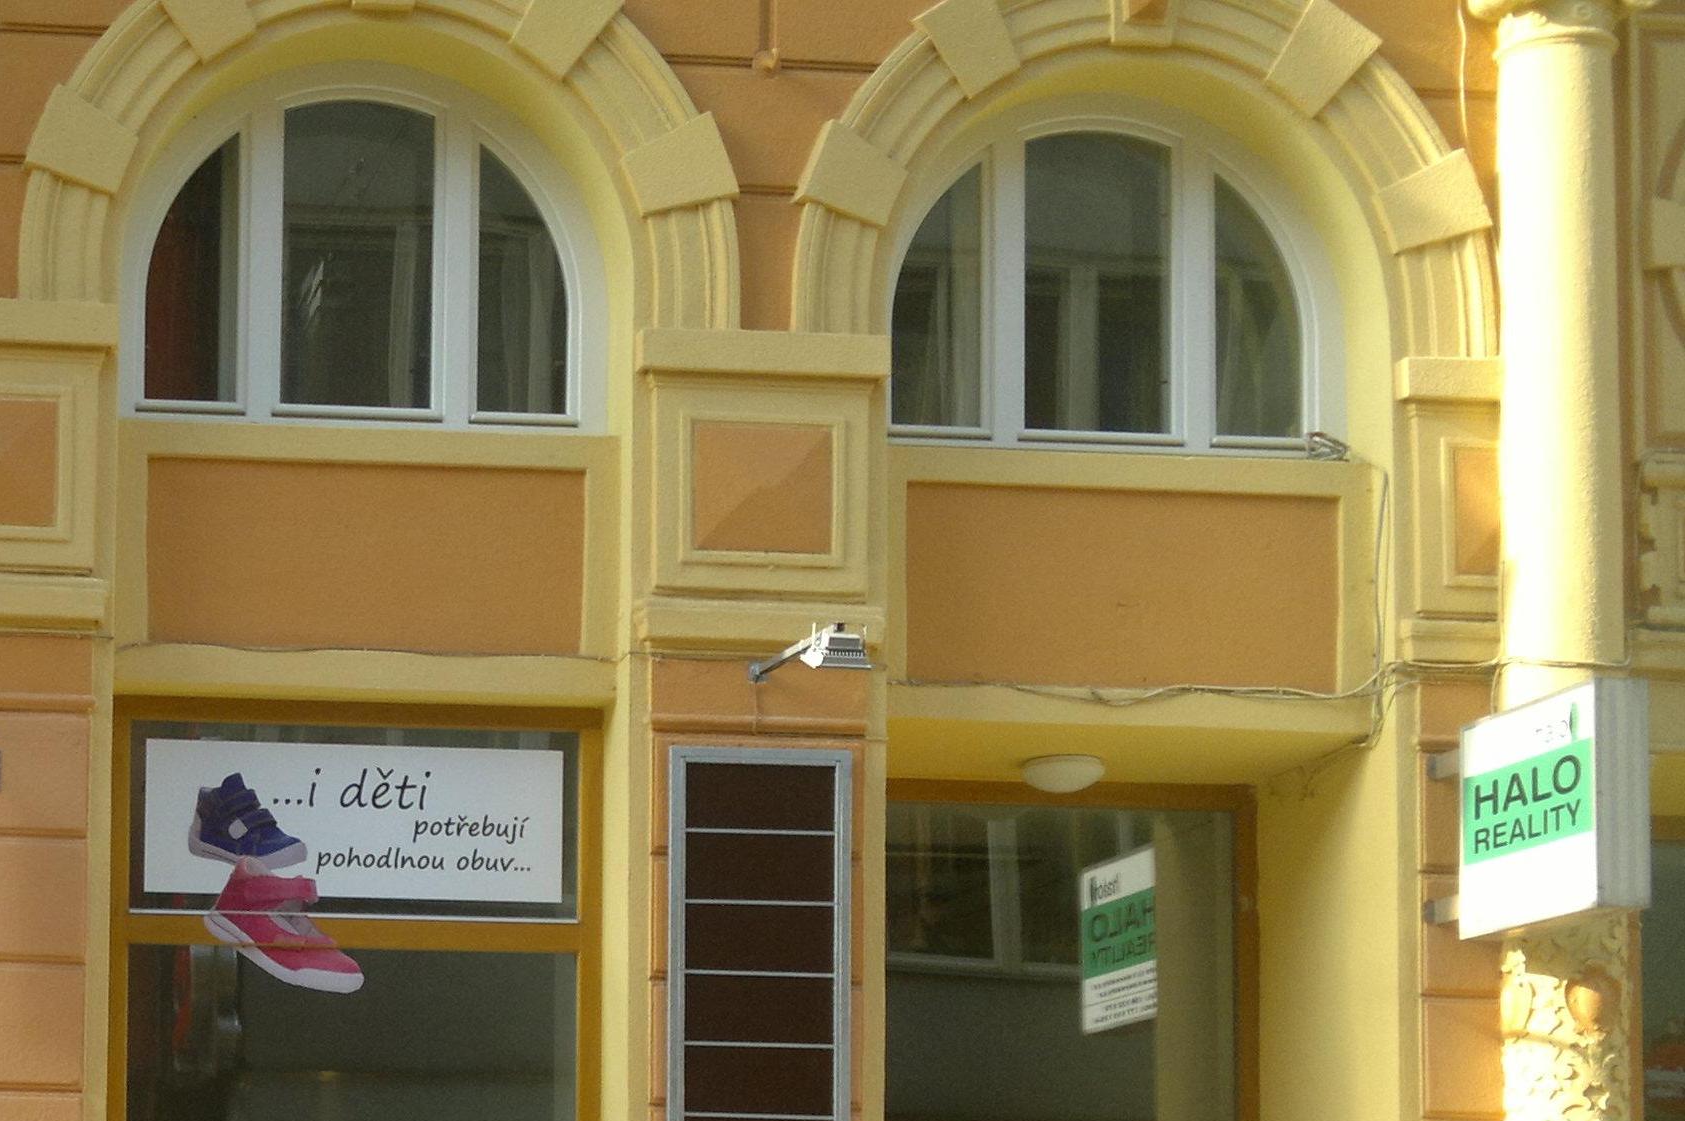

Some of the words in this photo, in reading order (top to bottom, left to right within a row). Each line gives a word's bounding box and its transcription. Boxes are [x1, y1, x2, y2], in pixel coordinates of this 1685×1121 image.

[340, 767, 432, 811] děti
[1474, 754, 1582, 821] HALO
[413, 815, 530, 845] potřebují
[1474, 798, 1581, 855] REALITY
[316, 847, 446, 874] pohodlnou
